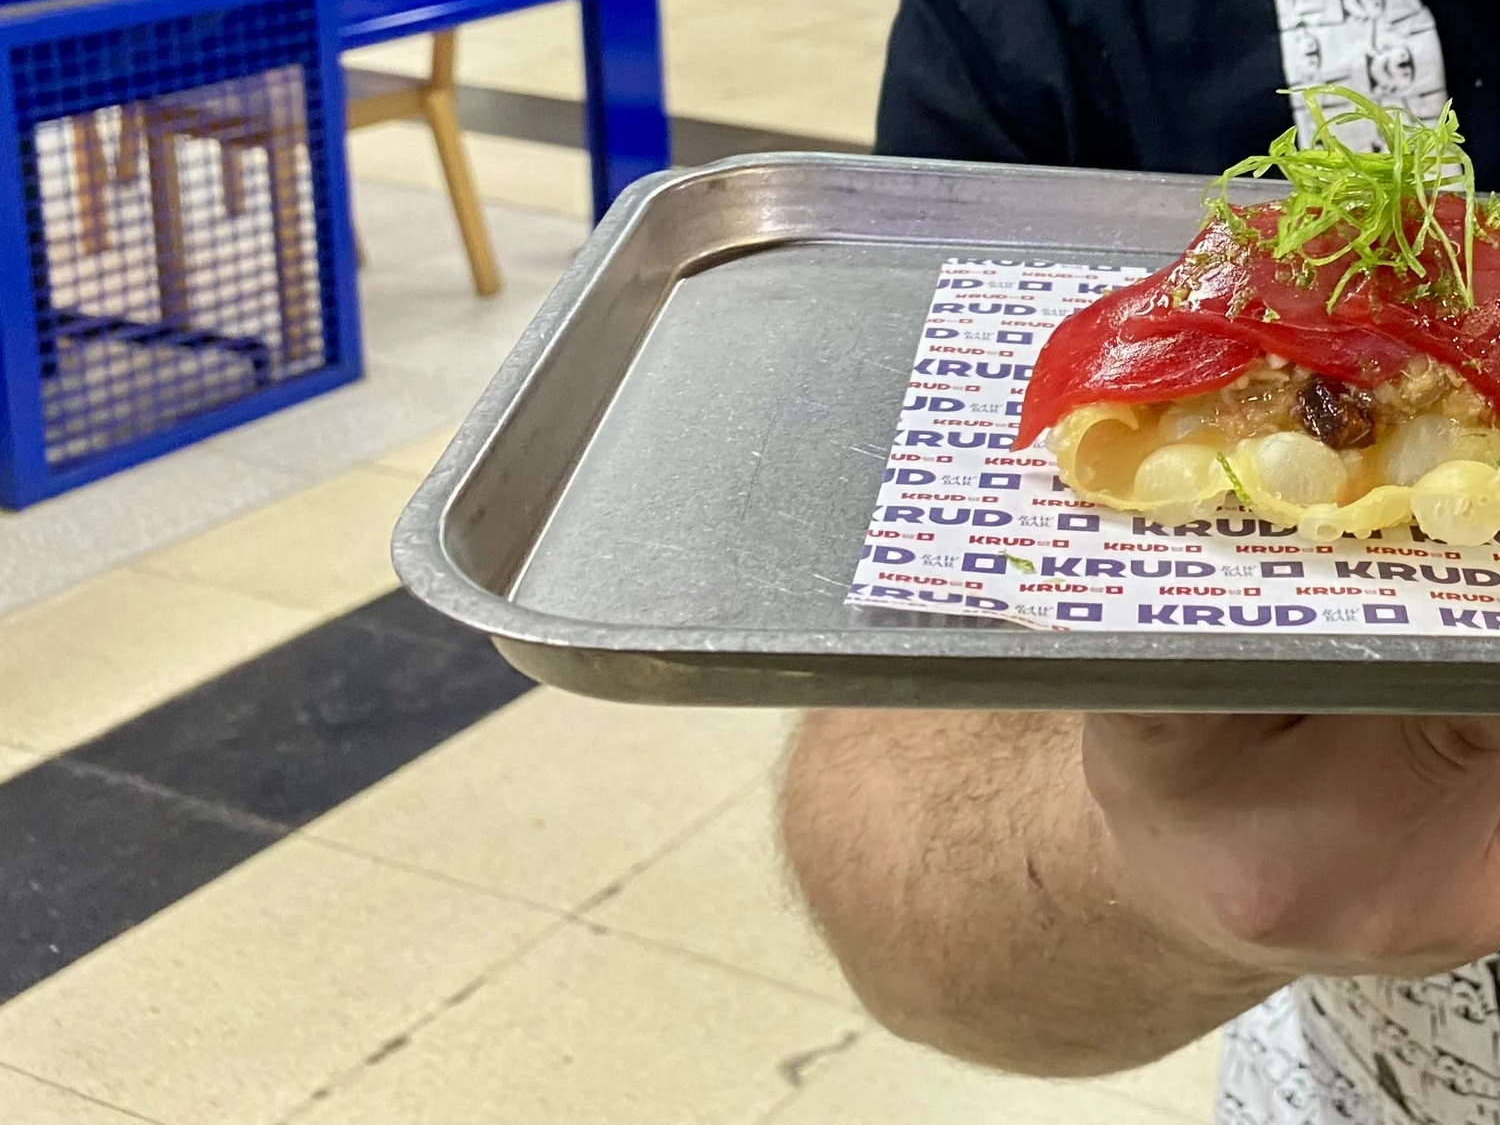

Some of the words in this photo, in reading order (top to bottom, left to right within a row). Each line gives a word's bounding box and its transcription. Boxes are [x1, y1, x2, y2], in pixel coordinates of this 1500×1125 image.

[1001, 320, 1055, 328] KRUD
[930, 345, 985, 355] KRUD
[933, 418, 993, 427] KRUD
[985, 457, 1047, 467] KRUD
[901, 492, 966, 502] KRUD
[969, 535, 1035, 547] KRUD
[1104, 542, 1169, 552] KRUD
[1236, 545, 1300, 554] KRUD
[1366, 546, 1428, 558] KRUD
[1041, 556, 1216, 578] KRUD
[878, 572, 946, 585] KRUD
[1019, 583, 1088, 593] KRUD
[1159, 586, 1227, 596] KRUD
[1295, 587, 1363, 596] KRUD
[1429, 591, 1495, 603] KRUD
[1138, 604, 1317, 627] KRUD
[1322, 608, 1360, 616] RAW
[1325, 614, 1357, 622] BAR
